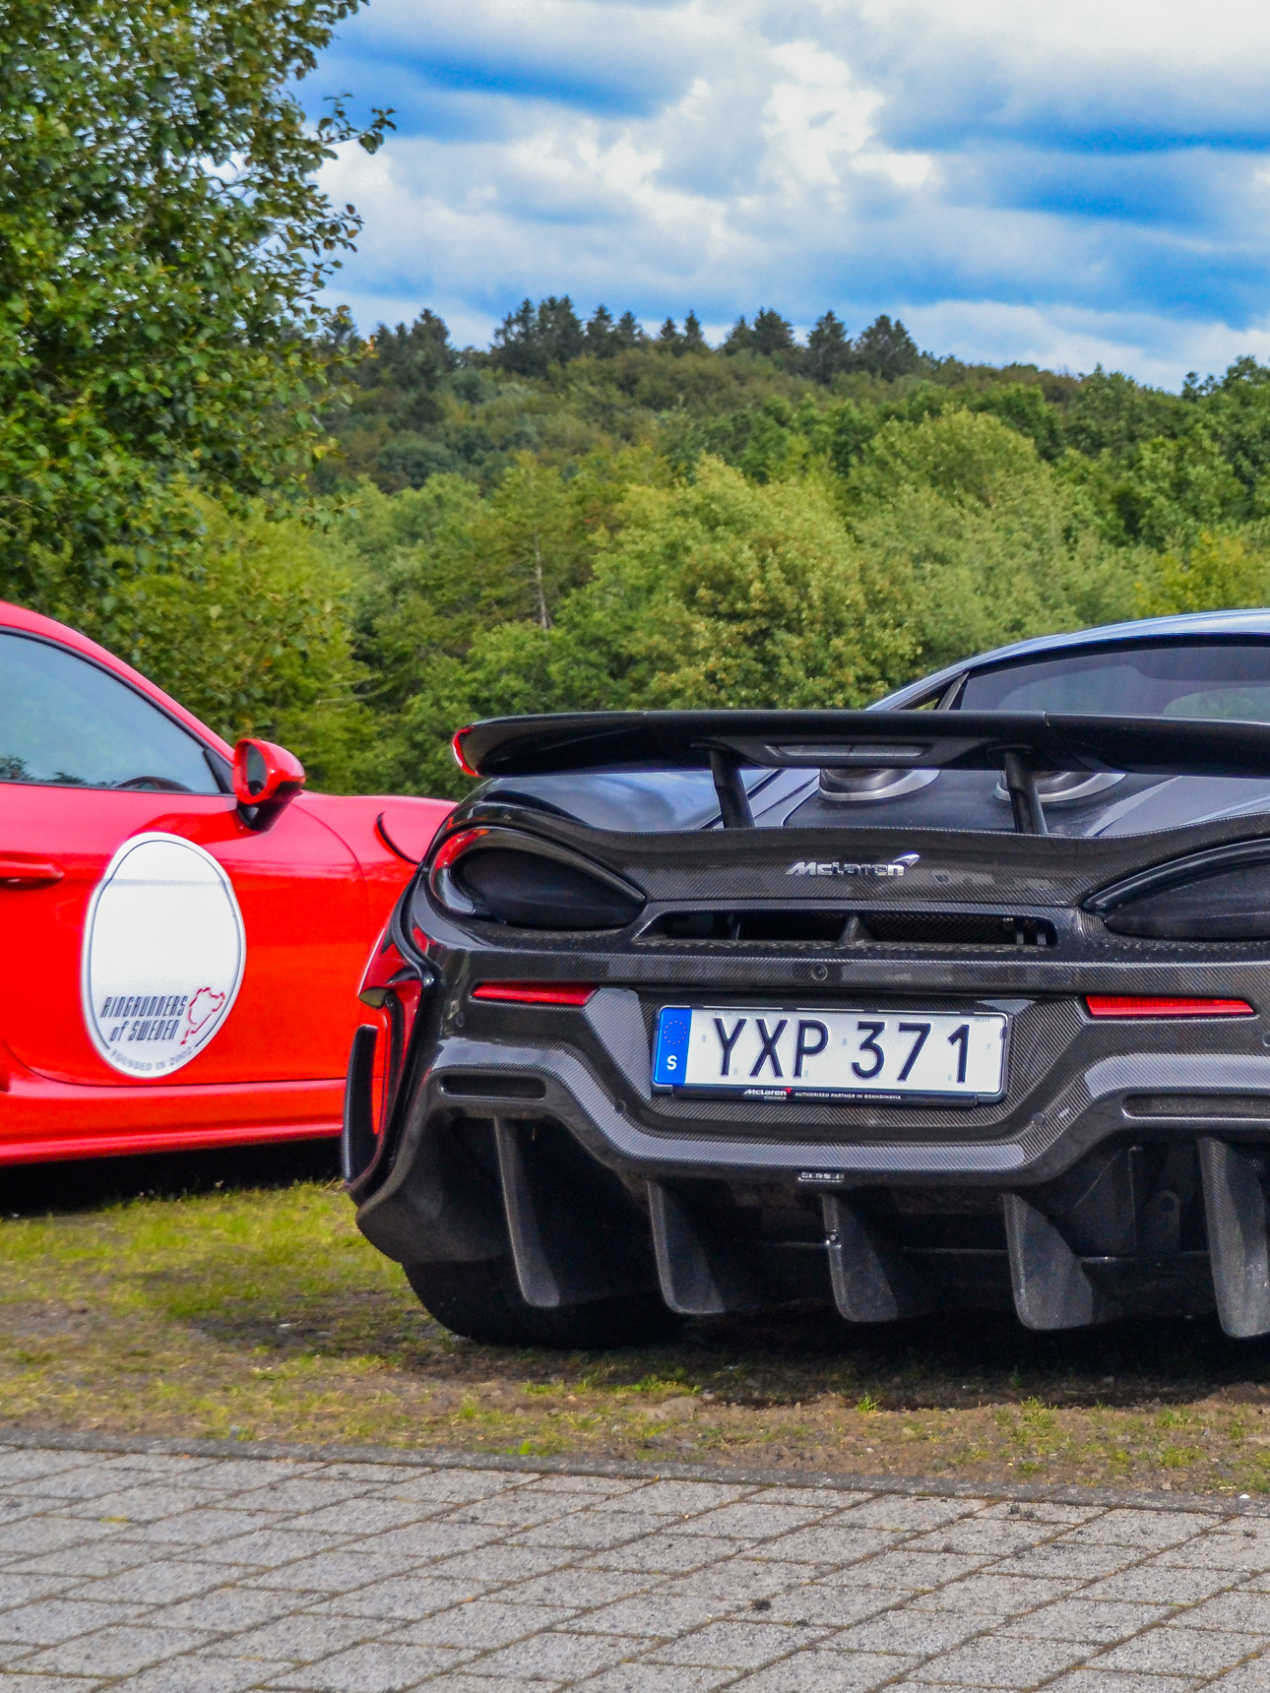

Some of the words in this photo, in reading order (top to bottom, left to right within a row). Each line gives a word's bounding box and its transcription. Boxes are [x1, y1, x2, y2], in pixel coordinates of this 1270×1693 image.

[785, 861, 905, 876] McLaren
[100, 995, 189, 1018] RINGRUNNERS
[109, 1020, 129, 1042] of
[128, 1019, 181, 1042] SWEDEN
[713, 1017, 830, 1079] YXP
[851, 1020, 971, 1084] 371
[666, 1055, 678, 1071] S
[743, 1088, 787, 1096] McLaren
